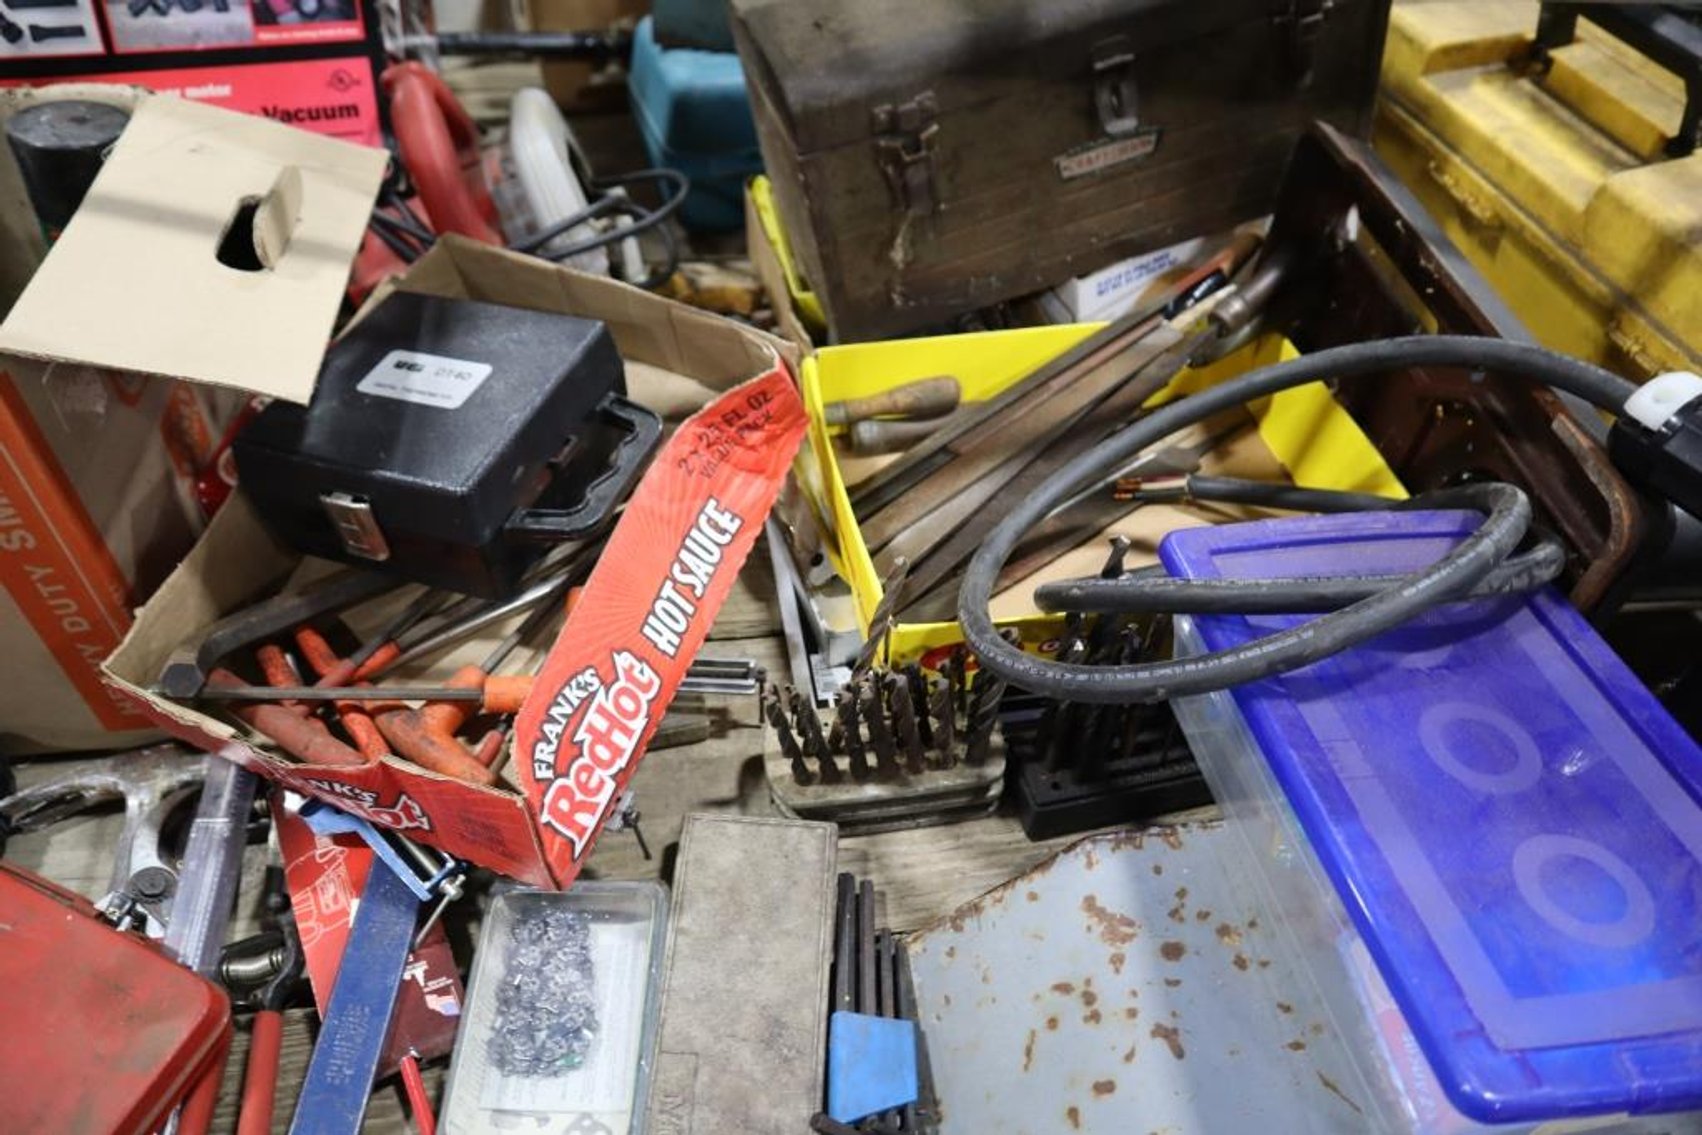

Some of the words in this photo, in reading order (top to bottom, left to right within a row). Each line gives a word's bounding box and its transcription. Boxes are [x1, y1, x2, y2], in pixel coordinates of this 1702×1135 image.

[722, 409, 748, 428] FL
[23, 563, 91, 633] DUTY
[641, 578, 697, 658] HOT
[671, 496, 744, 600] SAUCE
[533, 667, 602, 780] FRANK'S
[540, 651, 661, 859] RedHot
